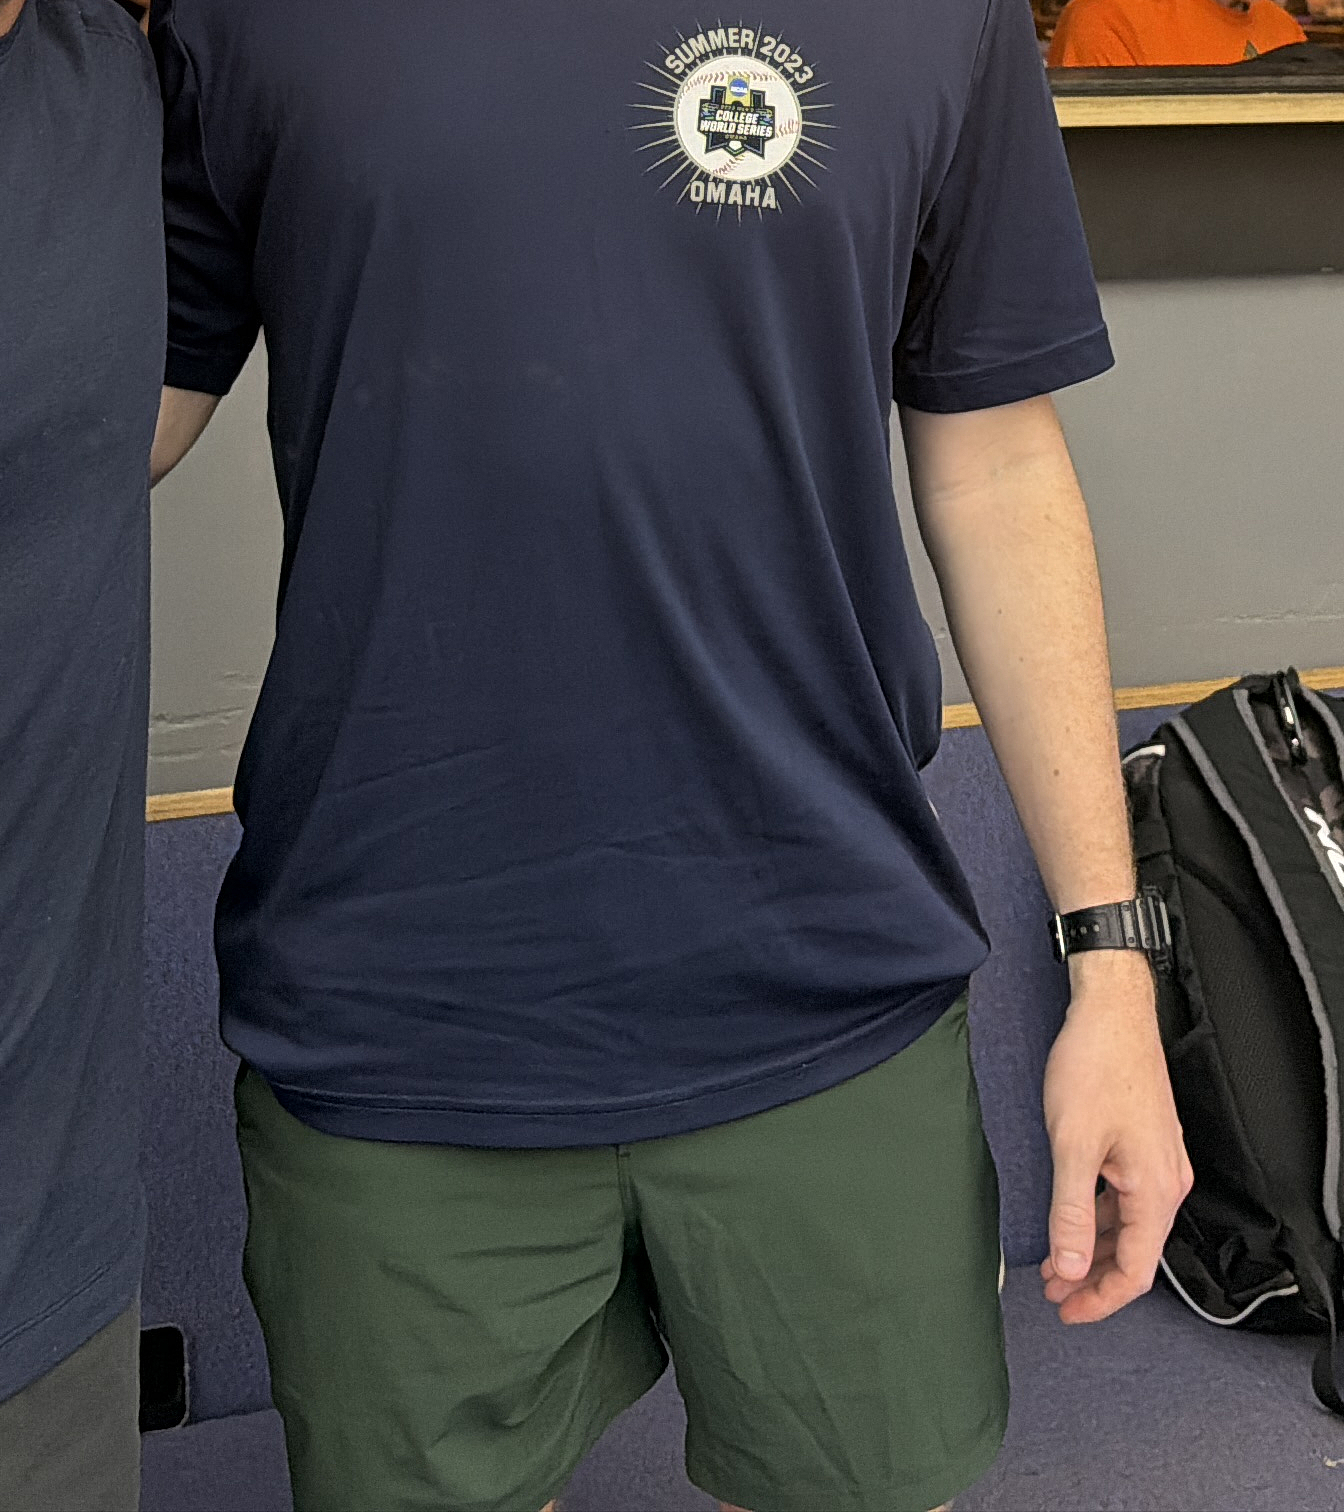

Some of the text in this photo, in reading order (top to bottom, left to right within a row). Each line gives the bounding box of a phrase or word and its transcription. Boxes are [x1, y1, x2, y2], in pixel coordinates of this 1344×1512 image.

[665, 28, 814, 84] SUMMER 2023
[716, 110, 759, 124] COLLEGE
[700, 120, 773, 138] WORLD SERIES
[689, 180, 777, 209] OMAHA
